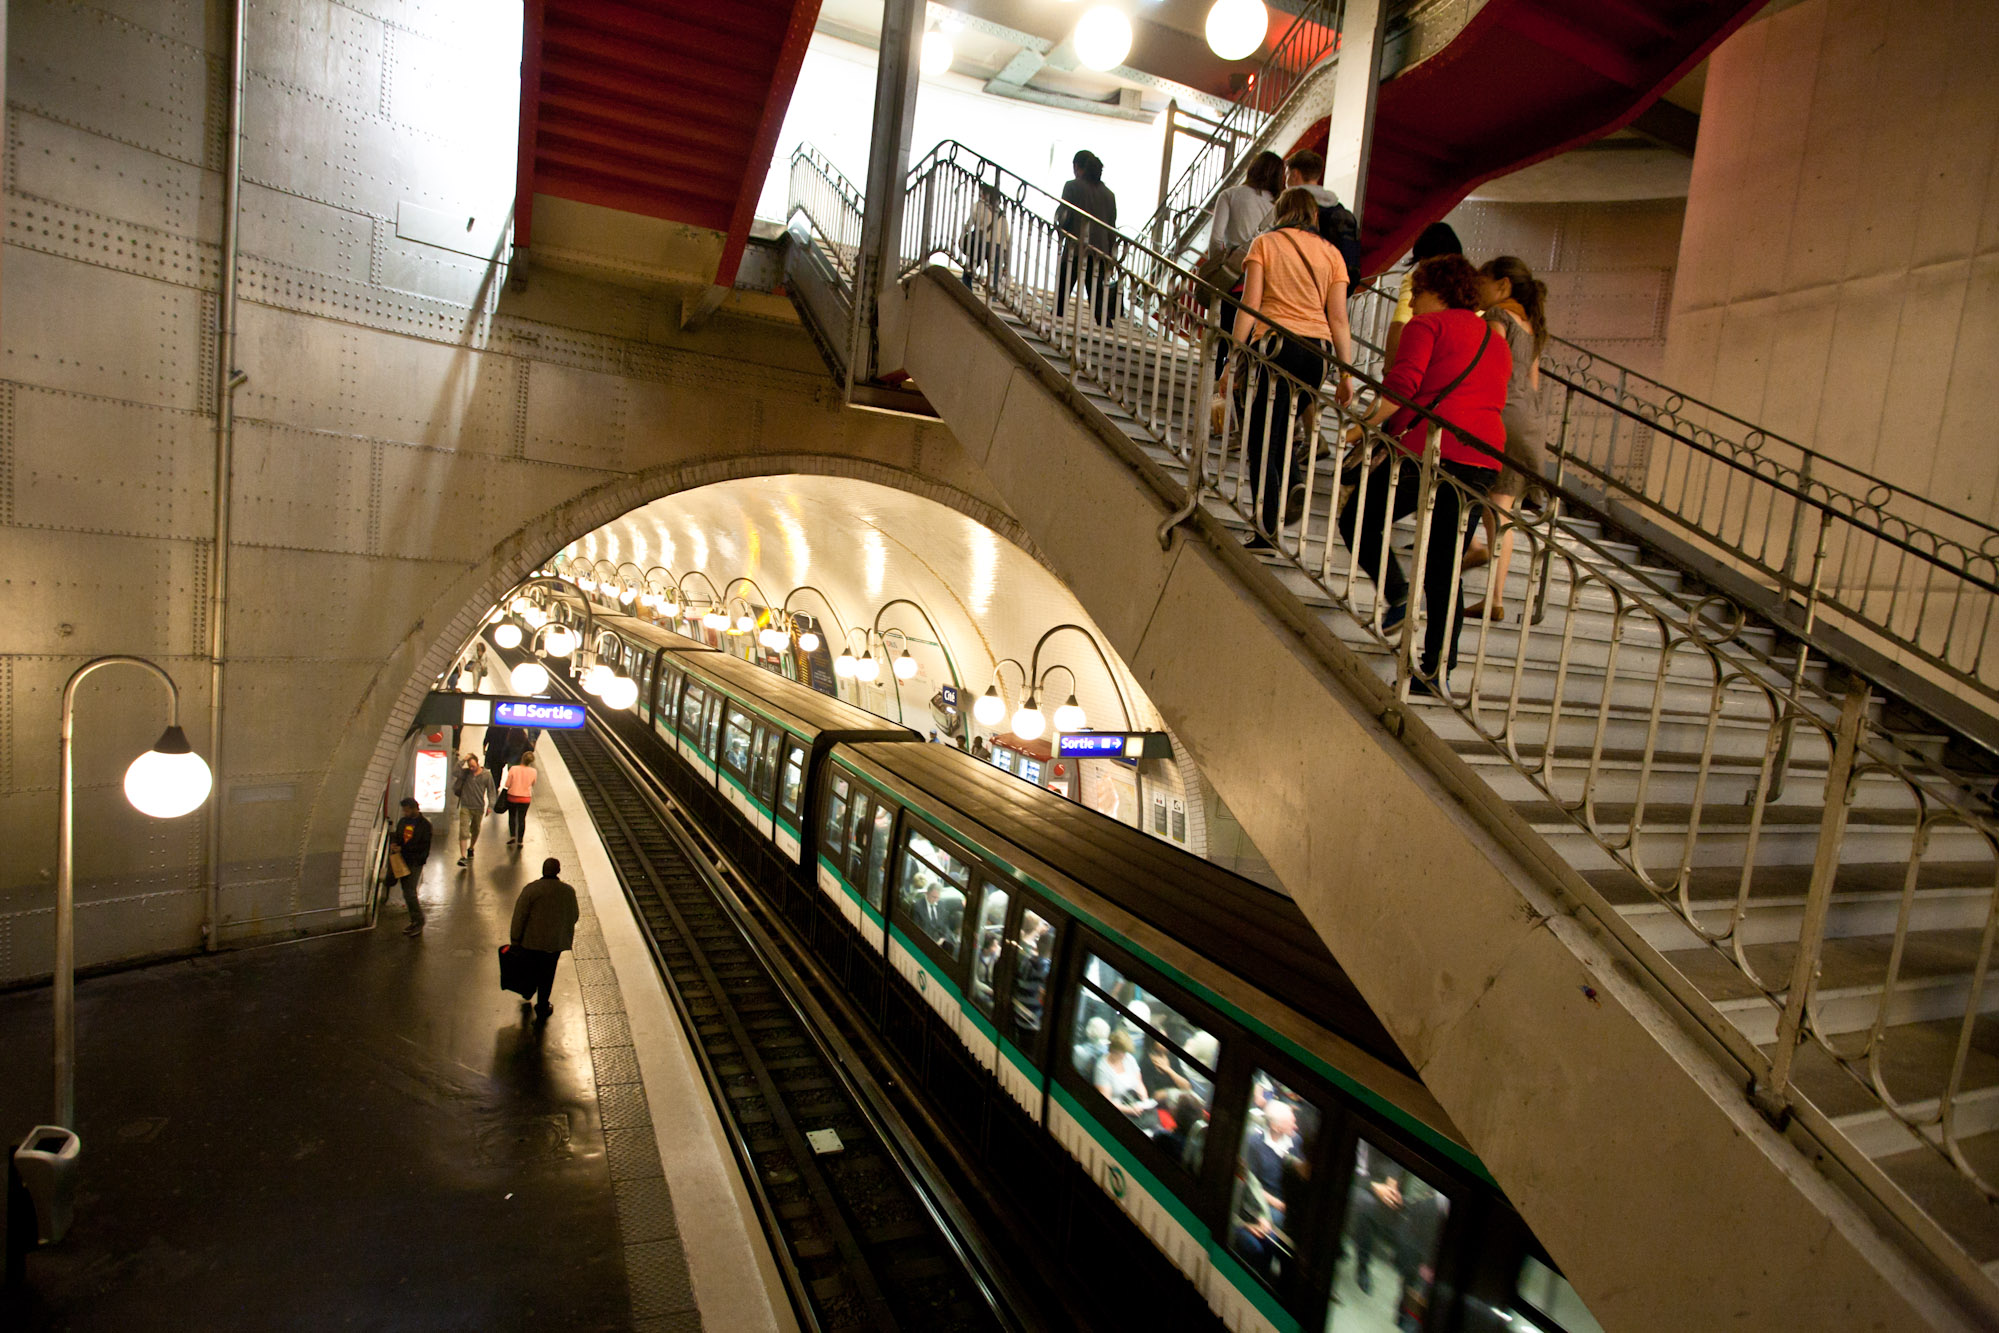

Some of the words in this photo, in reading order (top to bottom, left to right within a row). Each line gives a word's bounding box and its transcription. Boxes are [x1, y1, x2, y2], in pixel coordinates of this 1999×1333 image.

[944, 690, 956, 703] Cité
[527, 704, 573, 720] Sortie
[1061, 738, 1095, 750] Sortie
